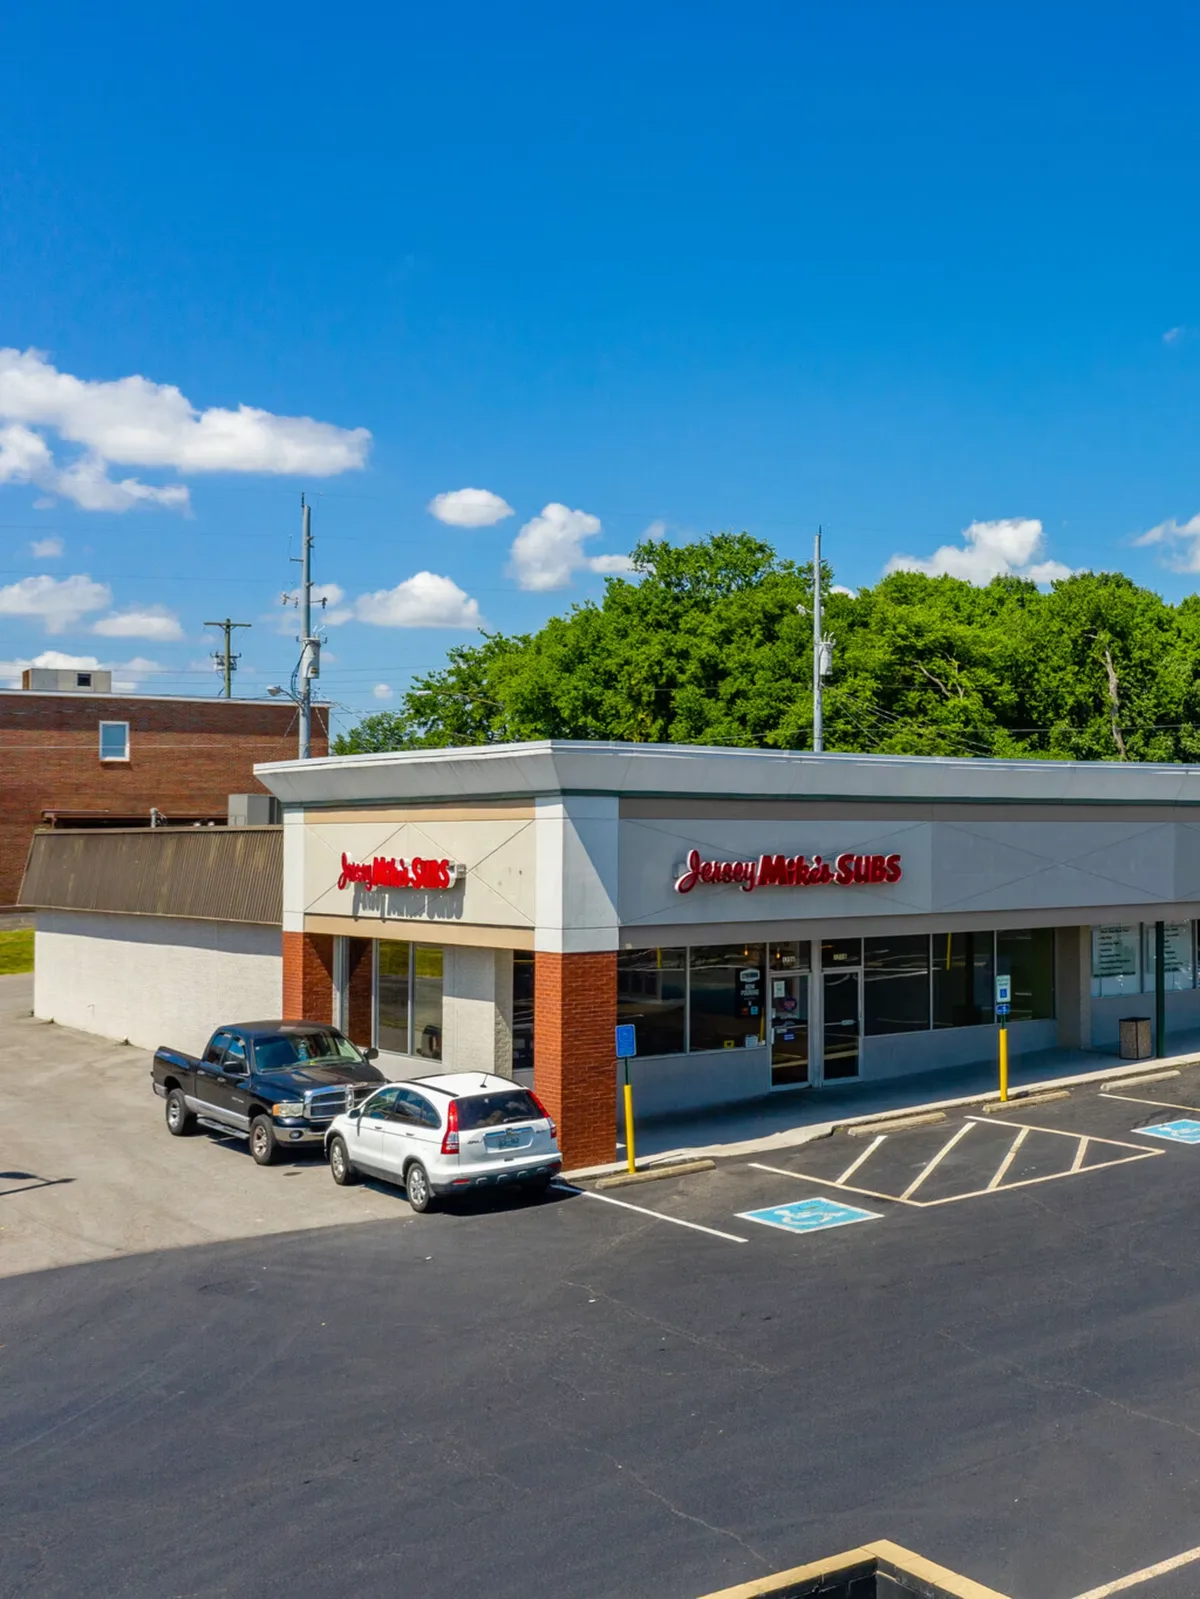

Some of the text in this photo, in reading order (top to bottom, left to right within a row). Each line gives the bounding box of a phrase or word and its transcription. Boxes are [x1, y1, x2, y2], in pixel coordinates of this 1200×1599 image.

[338, 852, 373, 891] Jersey
[411, 857, 451, 889] SUBS
[675, 849, 902, 894] Jersey Mike's SUBS
